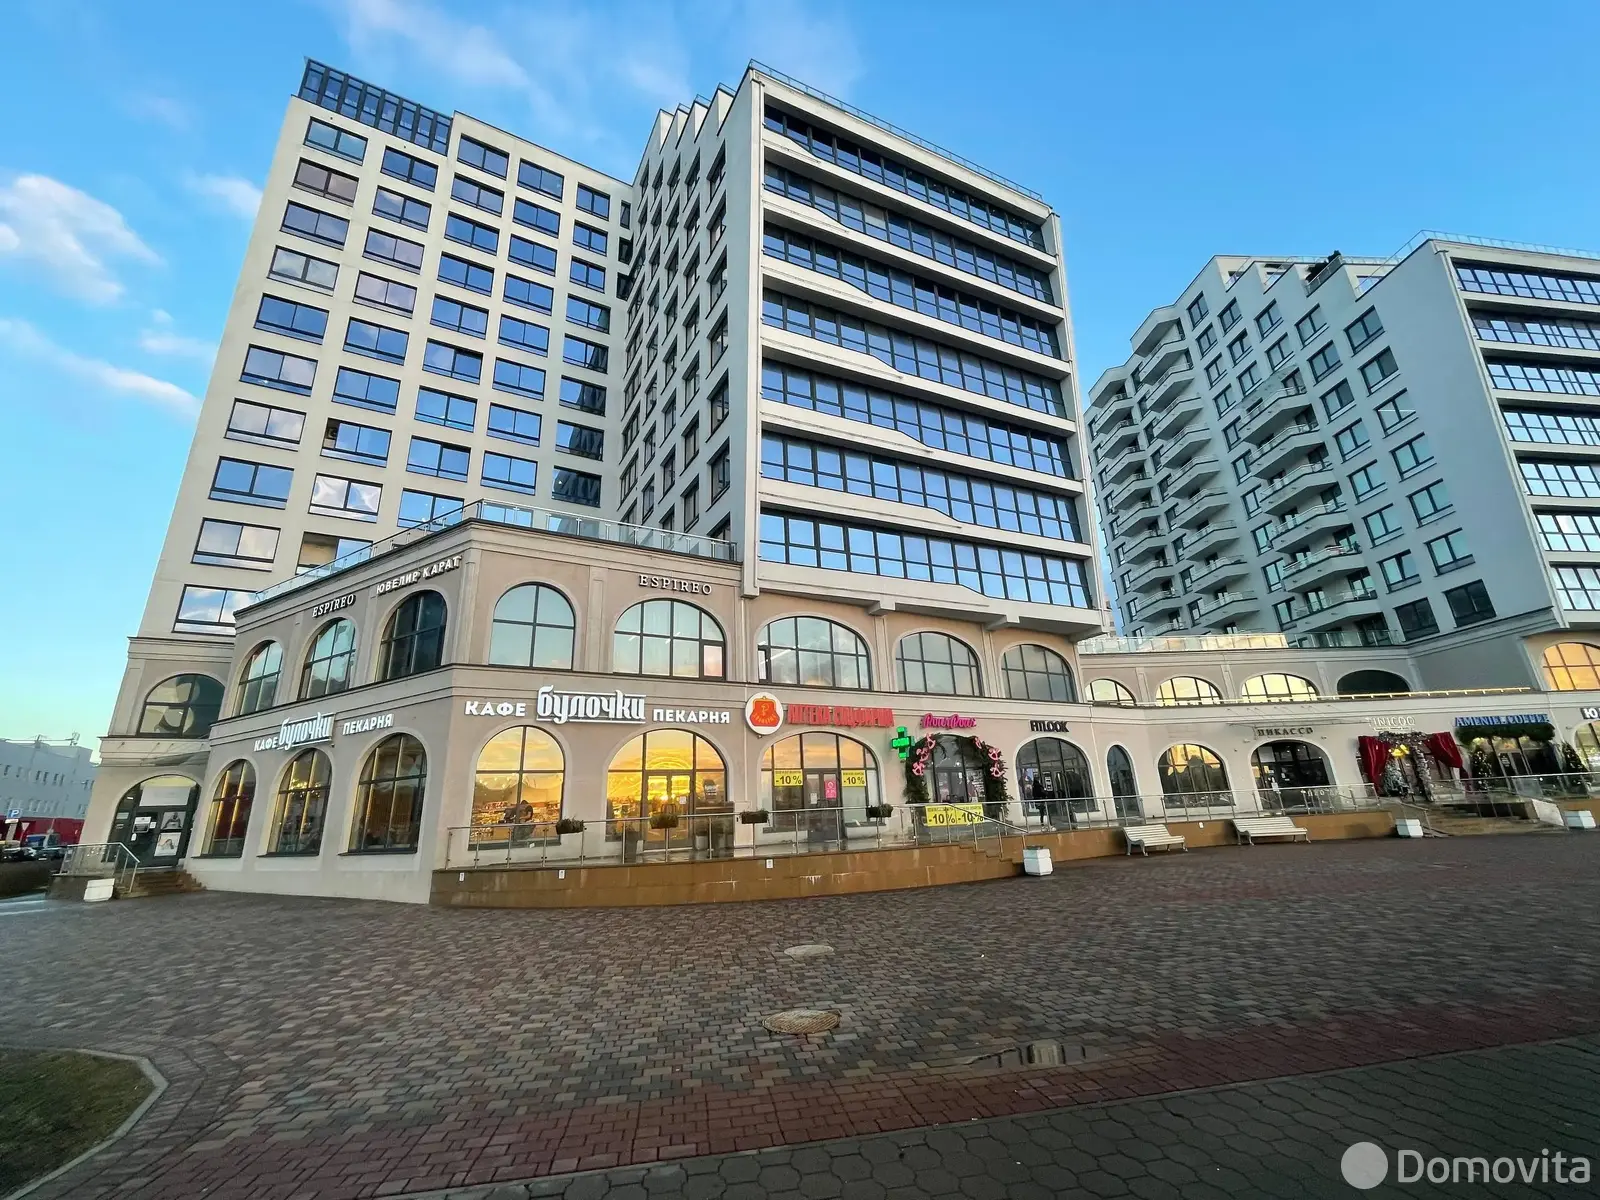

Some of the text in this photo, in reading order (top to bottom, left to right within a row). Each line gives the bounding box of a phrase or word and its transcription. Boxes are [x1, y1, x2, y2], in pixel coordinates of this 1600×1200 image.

[376, 556, 462, 595] ЮВЕЛИР КАРАТ
[639, 574, 712, 595] ESPIREO
[312, 594, 356, 618] ESPIREO
[464, 684, 731, 724] КАФЕ булочки ПЕКАРНЯ
[254, 736, 279, 752] КАФЕ
[343, 714, 394, 736] ПЕКАРНЯ
